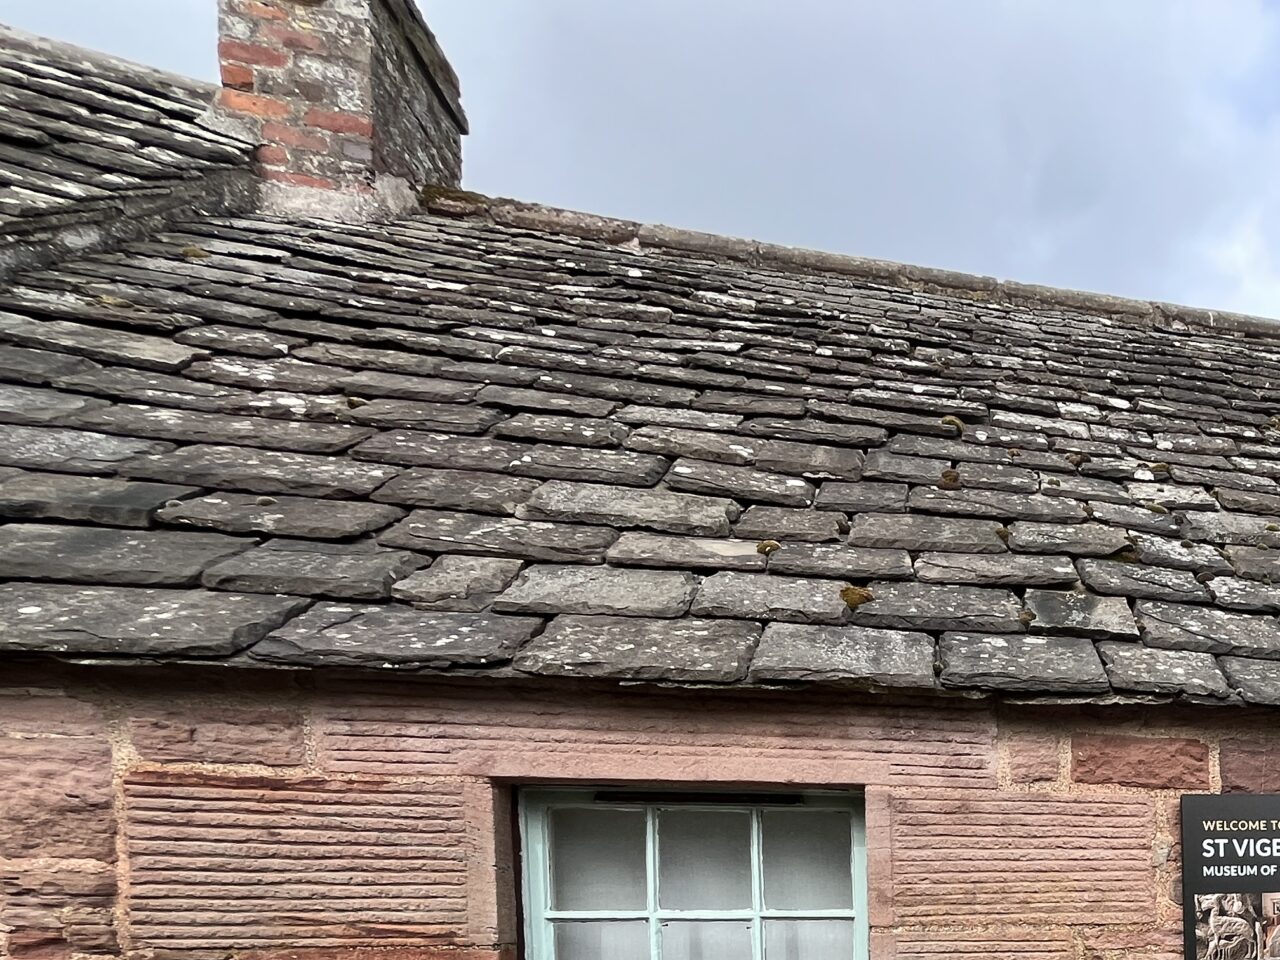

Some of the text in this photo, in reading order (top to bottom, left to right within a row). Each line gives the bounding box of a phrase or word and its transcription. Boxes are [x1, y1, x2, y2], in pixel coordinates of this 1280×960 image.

[1202, 820, 1267, 831] WELCOME
[1202, 838, 1228, 858] ST
[1202, 865, 1258, 876] MUSEUM
[1260, 865, 1277, 876] OF
